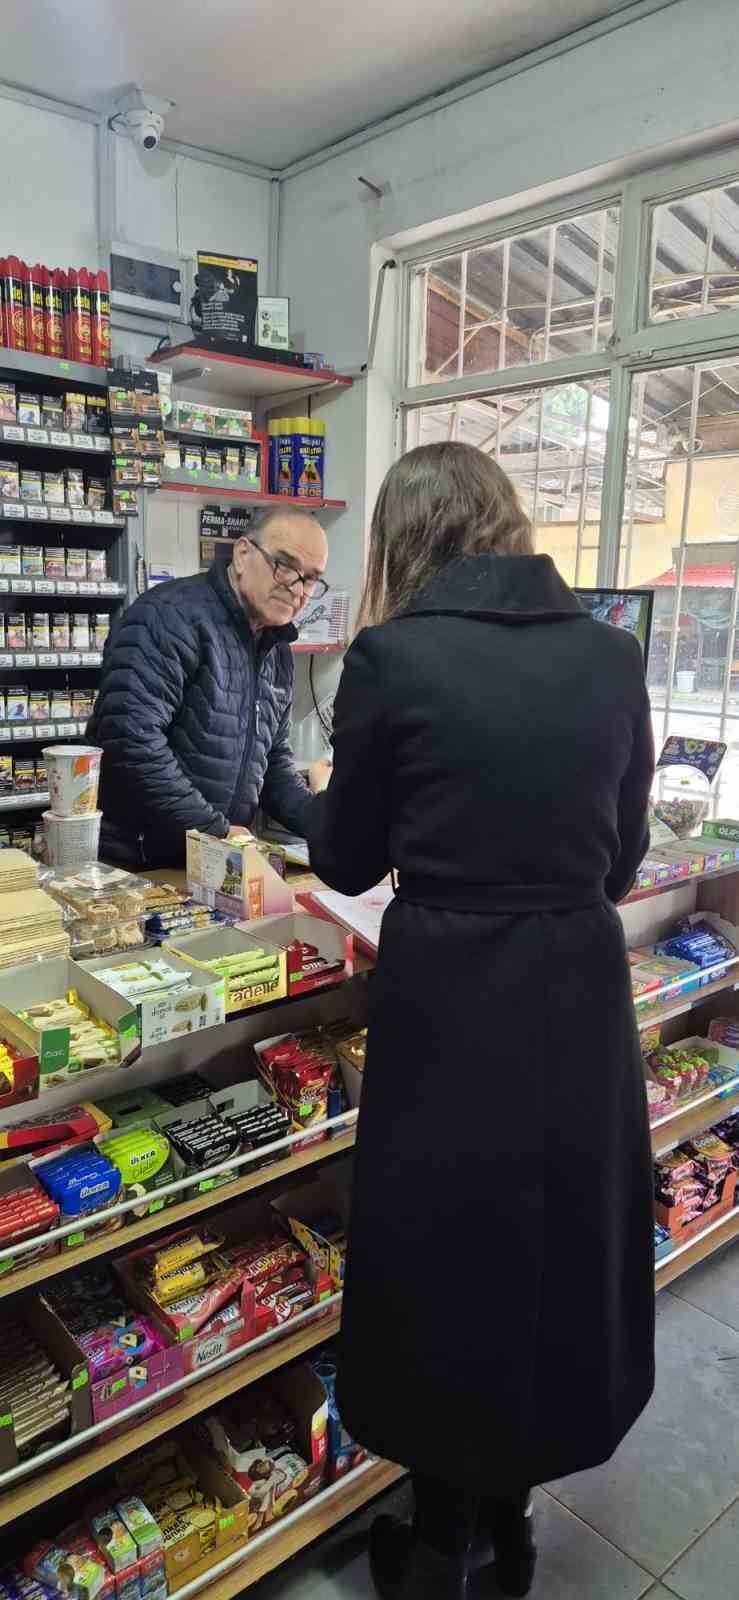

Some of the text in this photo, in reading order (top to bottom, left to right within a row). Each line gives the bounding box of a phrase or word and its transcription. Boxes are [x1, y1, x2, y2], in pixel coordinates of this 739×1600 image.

[202, 515, 249, 527] PERMA-SHARP
[228, 982, 279, 1002] adelle
[130, 1150, 156, 1166] ÜLKER
